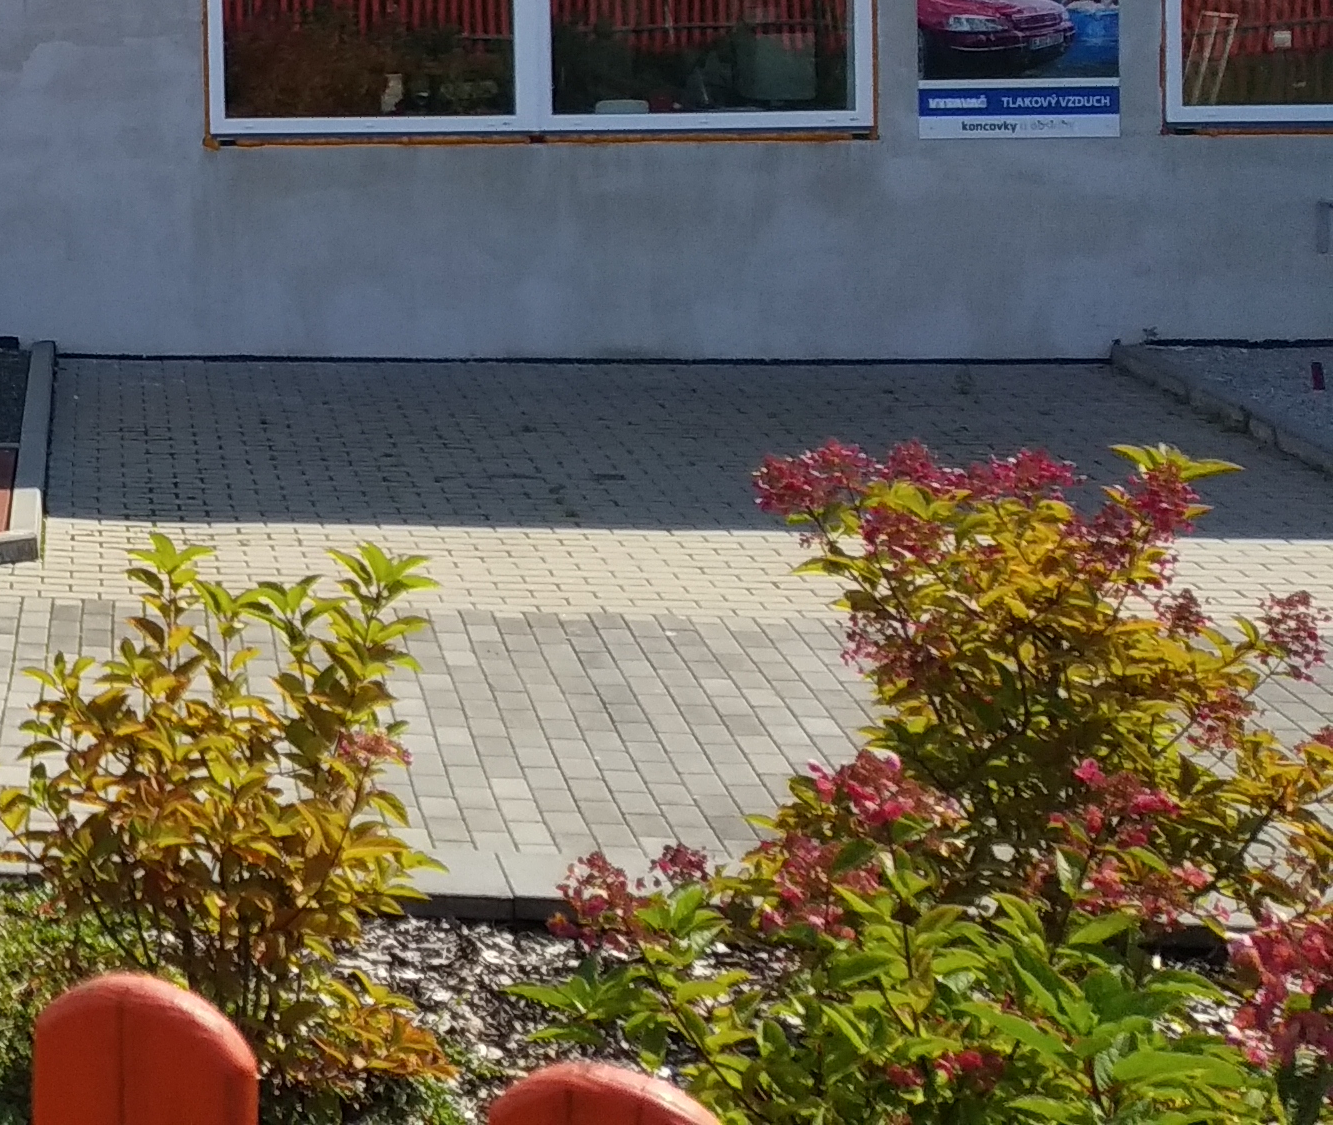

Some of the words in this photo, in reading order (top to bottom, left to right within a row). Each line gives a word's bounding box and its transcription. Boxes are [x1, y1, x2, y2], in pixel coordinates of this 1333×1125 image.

[1001, 94, 1057, 108] TLAKOVÝ
[1059, 95, 1110, 107] VZDUCH
[961, 120, 1018, 134] koncovky
